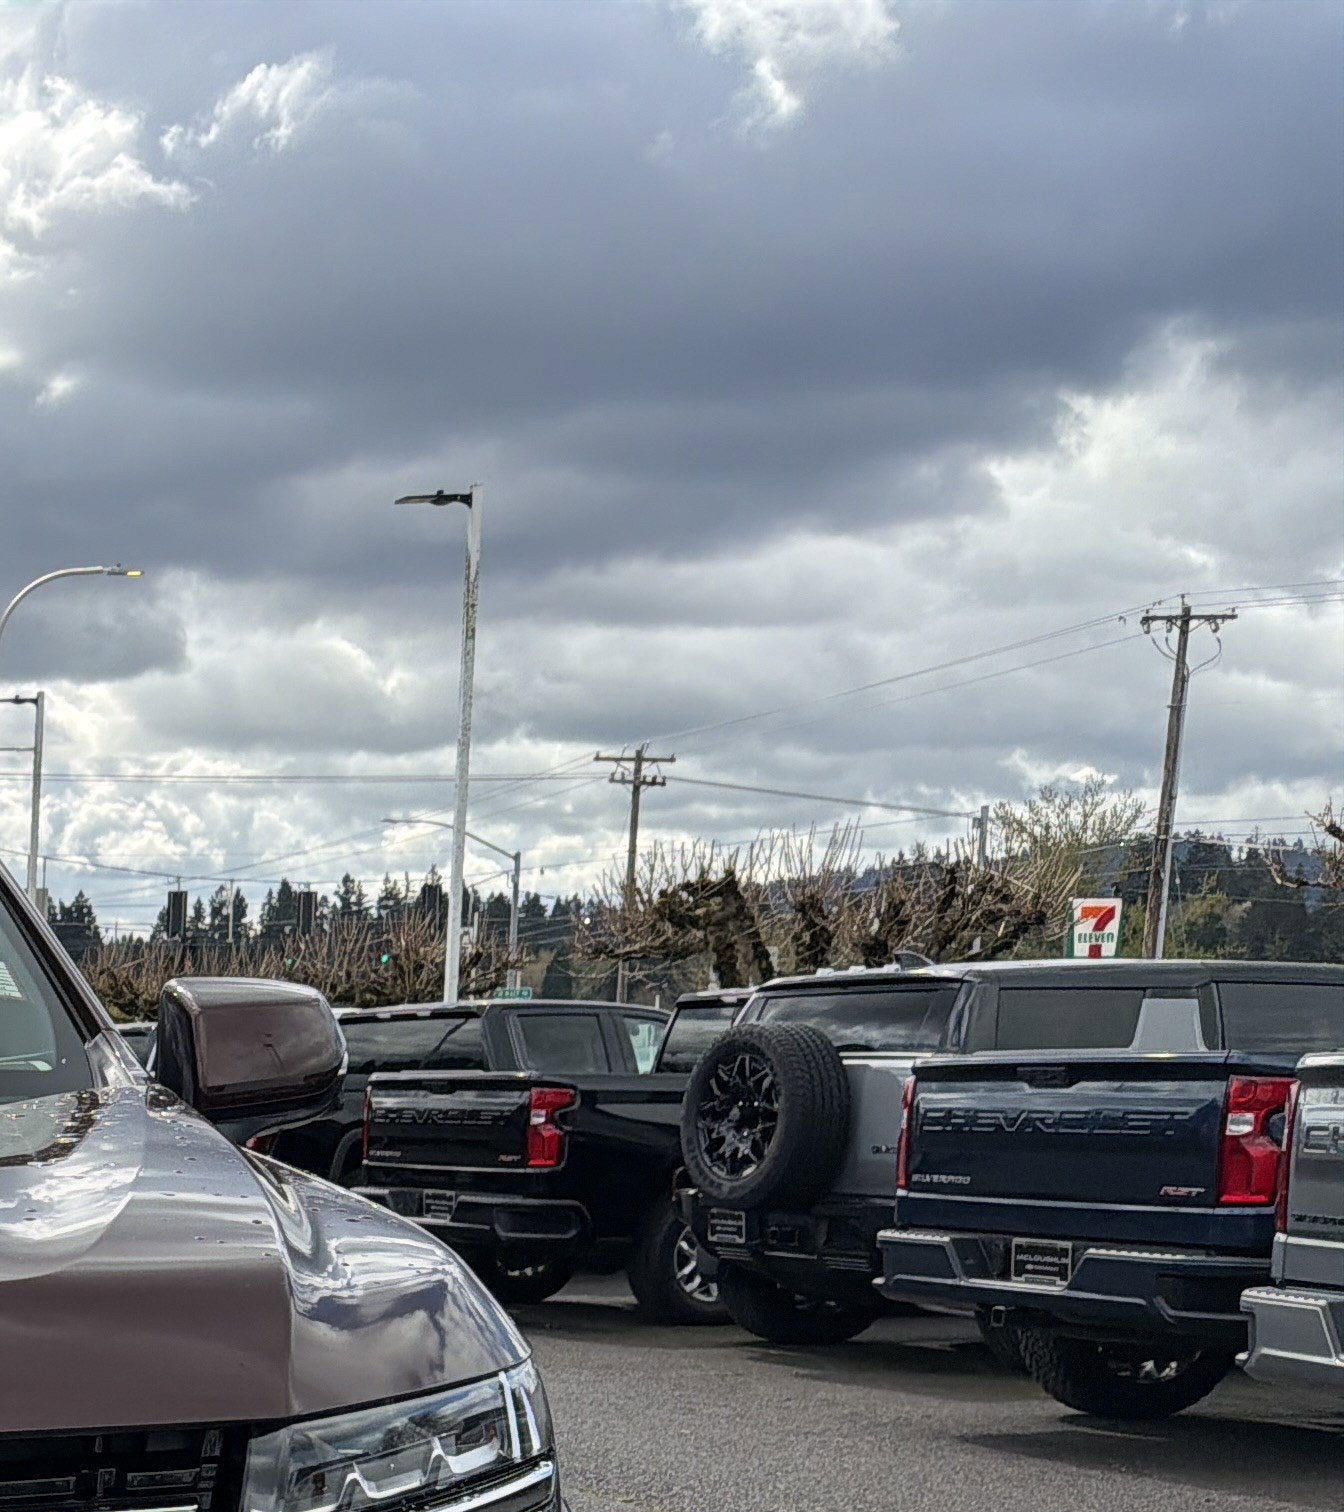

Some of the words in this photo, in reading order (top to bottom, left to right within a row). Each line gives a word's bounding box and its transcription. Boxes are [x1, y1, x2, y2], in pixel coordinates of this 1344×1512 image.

[1081, 905, 1116, 932] 7
[374, 1109, 512, 1126] CHEVROLET
[922, 1109, 1190, 1135] CHEVROLET
[1160, 1186, 1205, 1197] RST
